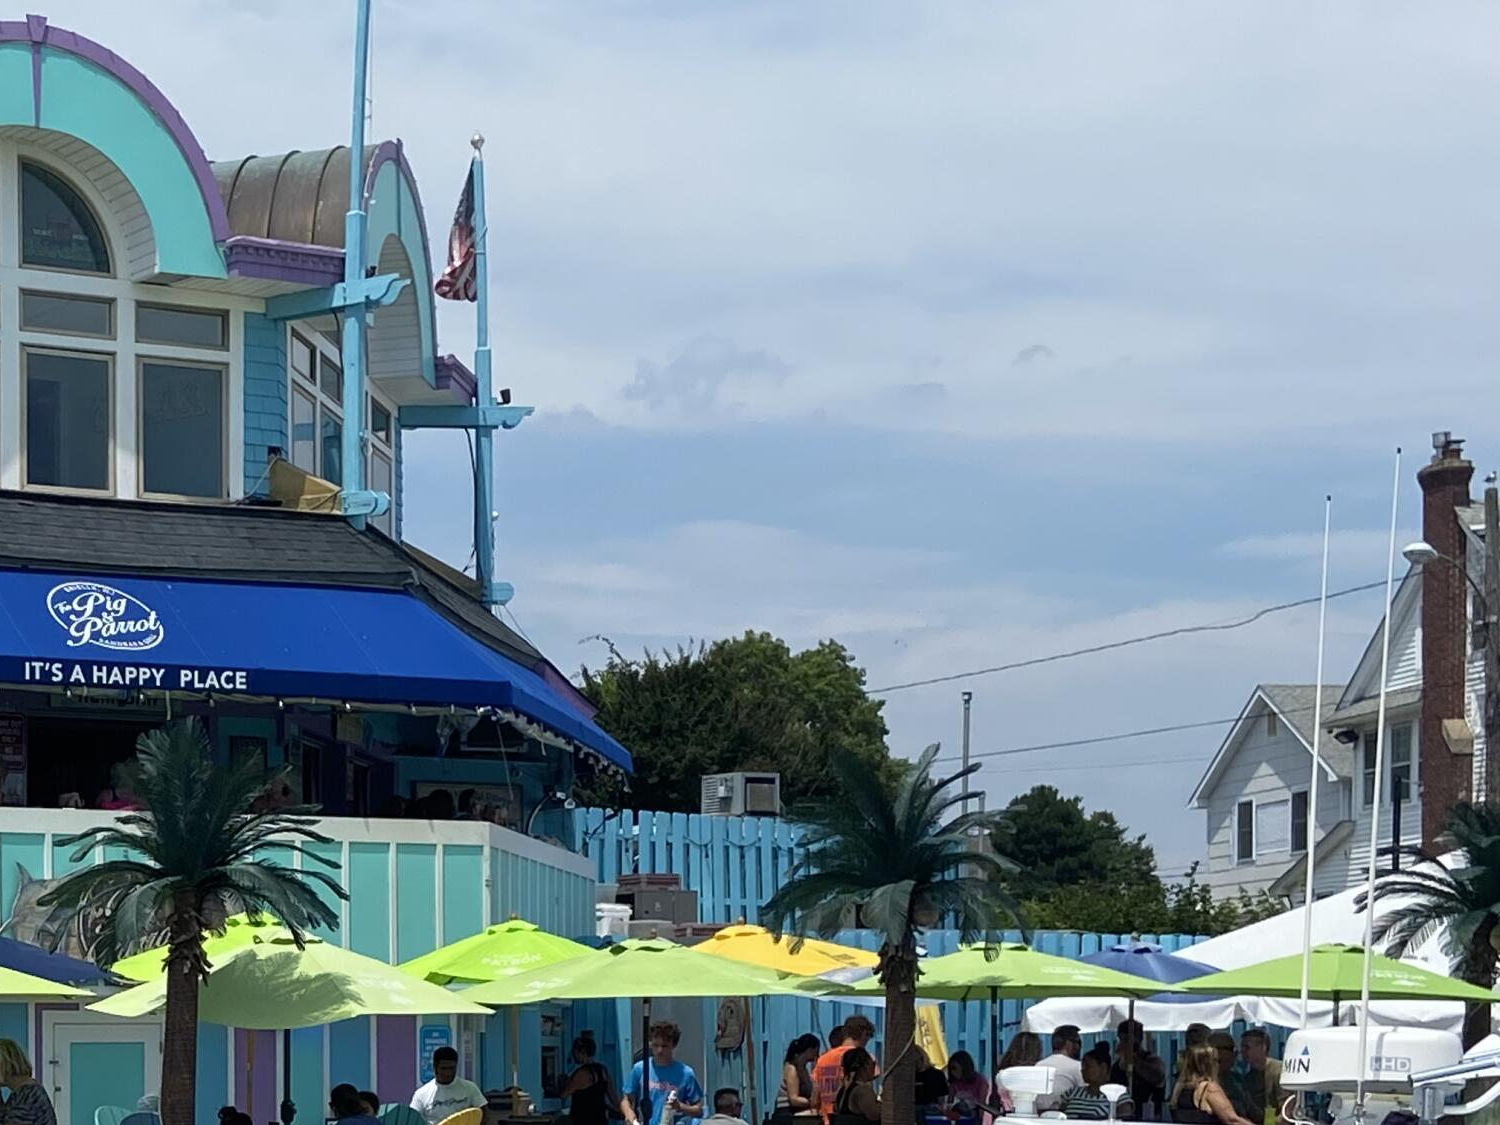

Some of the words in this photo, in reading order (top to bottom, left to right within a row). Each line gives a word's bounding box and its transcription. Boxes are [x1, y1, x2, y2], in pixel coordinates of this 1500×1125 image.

[70, 592, 128, 620] Pig
[67, 610, 161, 647] Parrot
[24, 661, 63, 682] IT'S
[69, 664, 86, 683] A
[92, 665, 166, 687] HAPPY
[180, 669, 248, 690] PLACE
